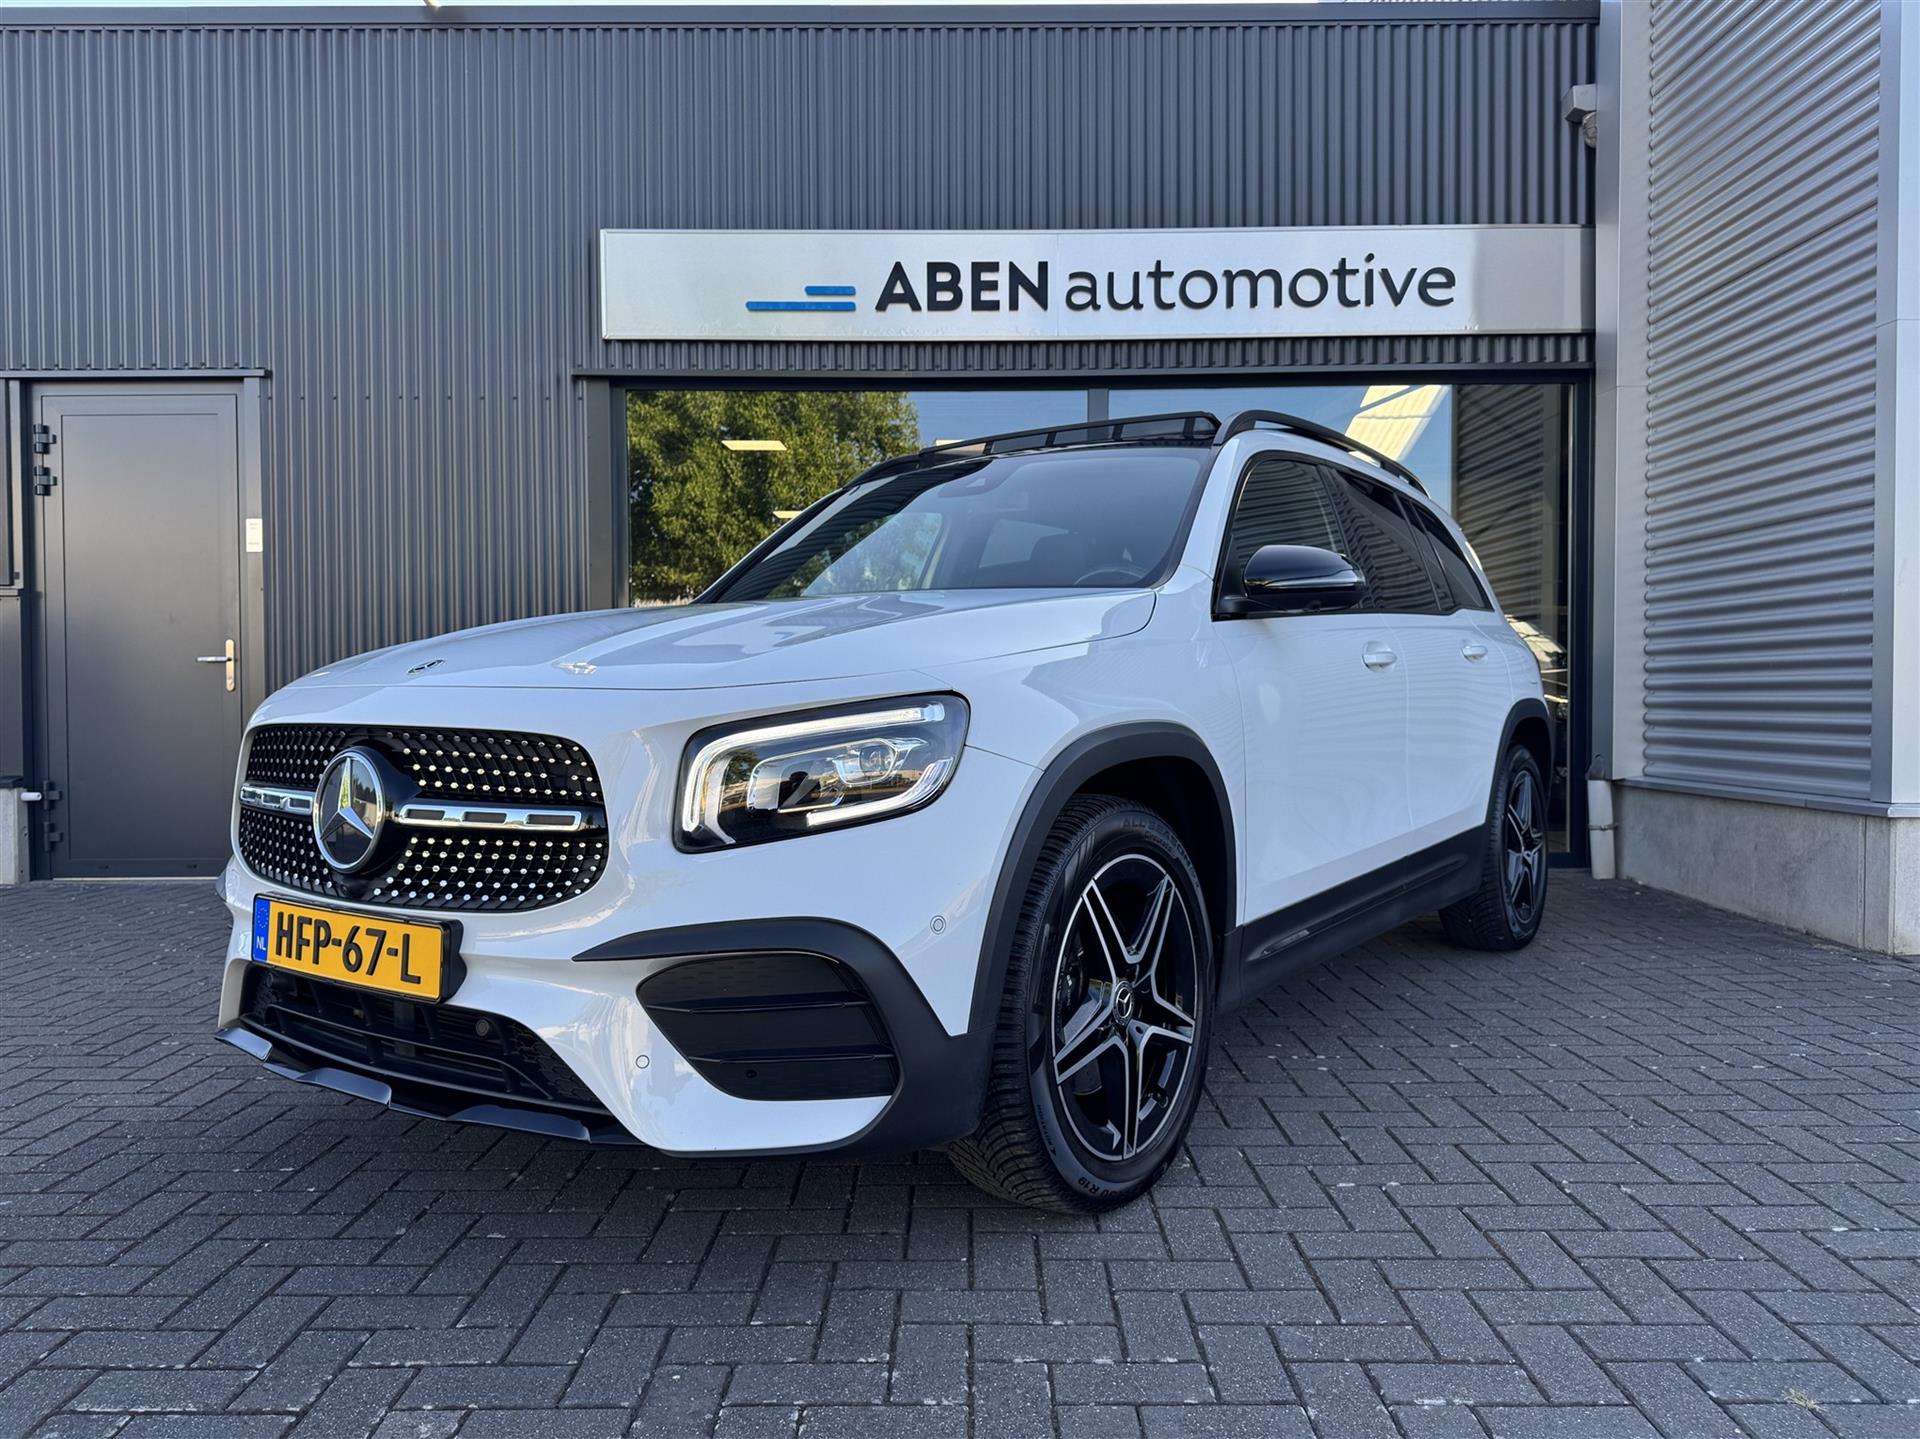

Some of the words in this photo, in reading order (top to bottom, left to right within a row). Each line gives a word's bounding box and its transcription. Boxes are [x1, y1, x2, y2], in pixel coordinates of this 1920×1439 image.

[875, 261, 1050, 312] ABEN
[1065, 253, 1456, 312] automotive
[256, 935, 267, 952] NL
[275, 911, 422, 985] HFP-67-L
